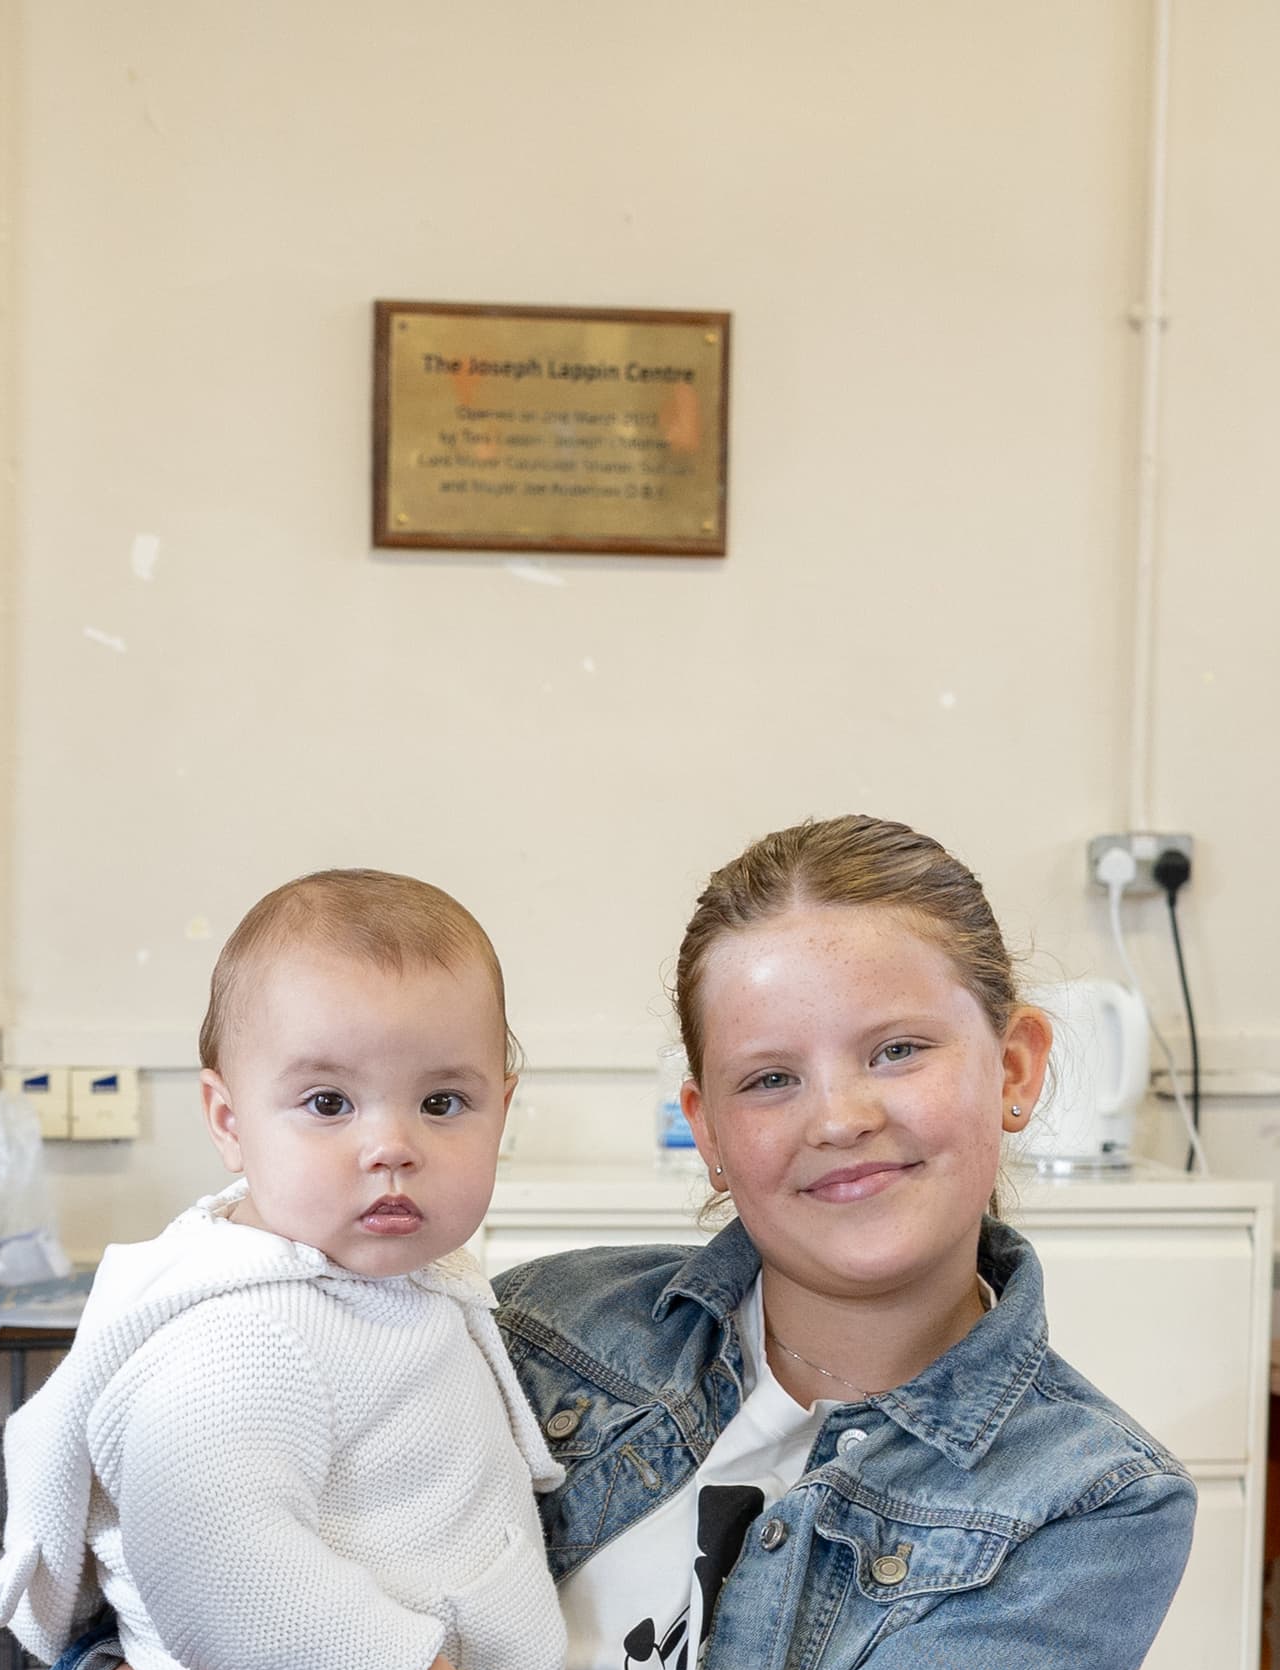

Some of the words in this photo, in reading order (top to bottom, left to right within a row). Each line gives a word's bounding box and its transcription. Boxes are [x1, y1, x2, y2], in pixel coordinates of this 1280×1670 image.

[422, 353, 462, 375] The
[468, 357, 542, 382] Joseph
[547, 360, 619, 384] Lappin
[625, 361, 696, 385] Centre
